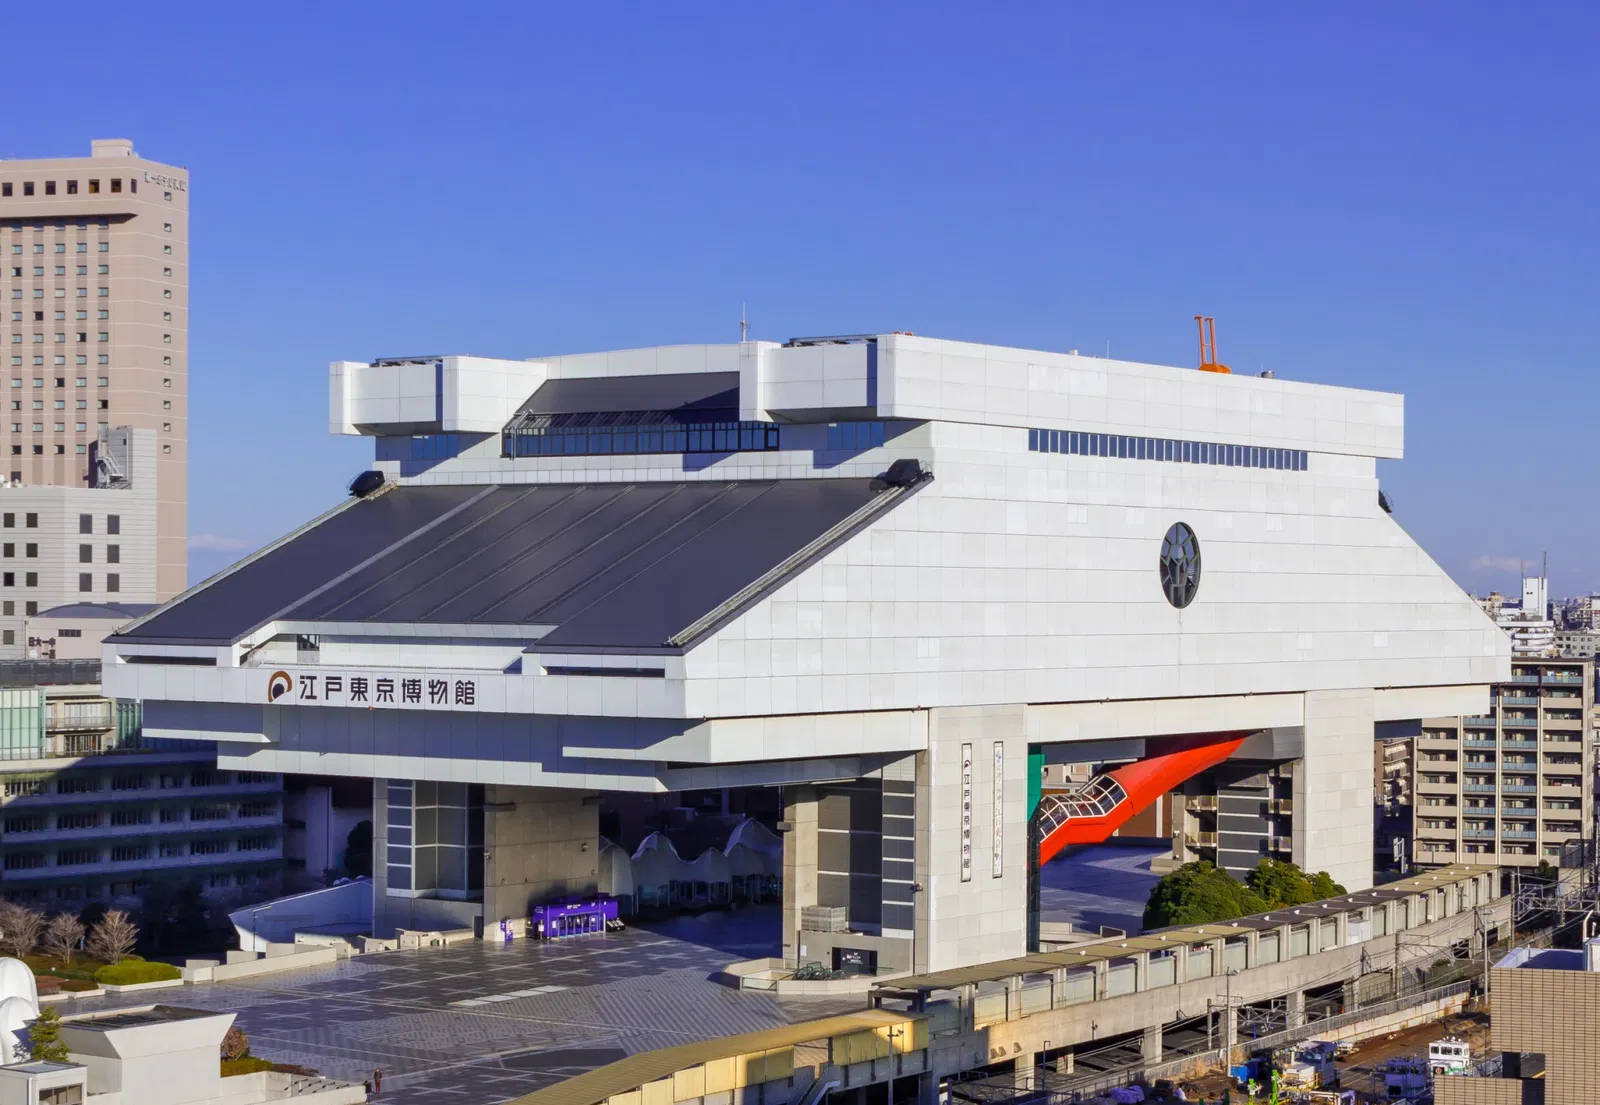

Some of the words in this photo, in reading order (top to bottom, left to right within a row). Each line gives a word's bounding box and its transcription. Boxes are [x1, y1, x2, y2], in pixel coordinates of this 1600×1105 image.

[300, 675, 475, 705] 江戸東京博物館
